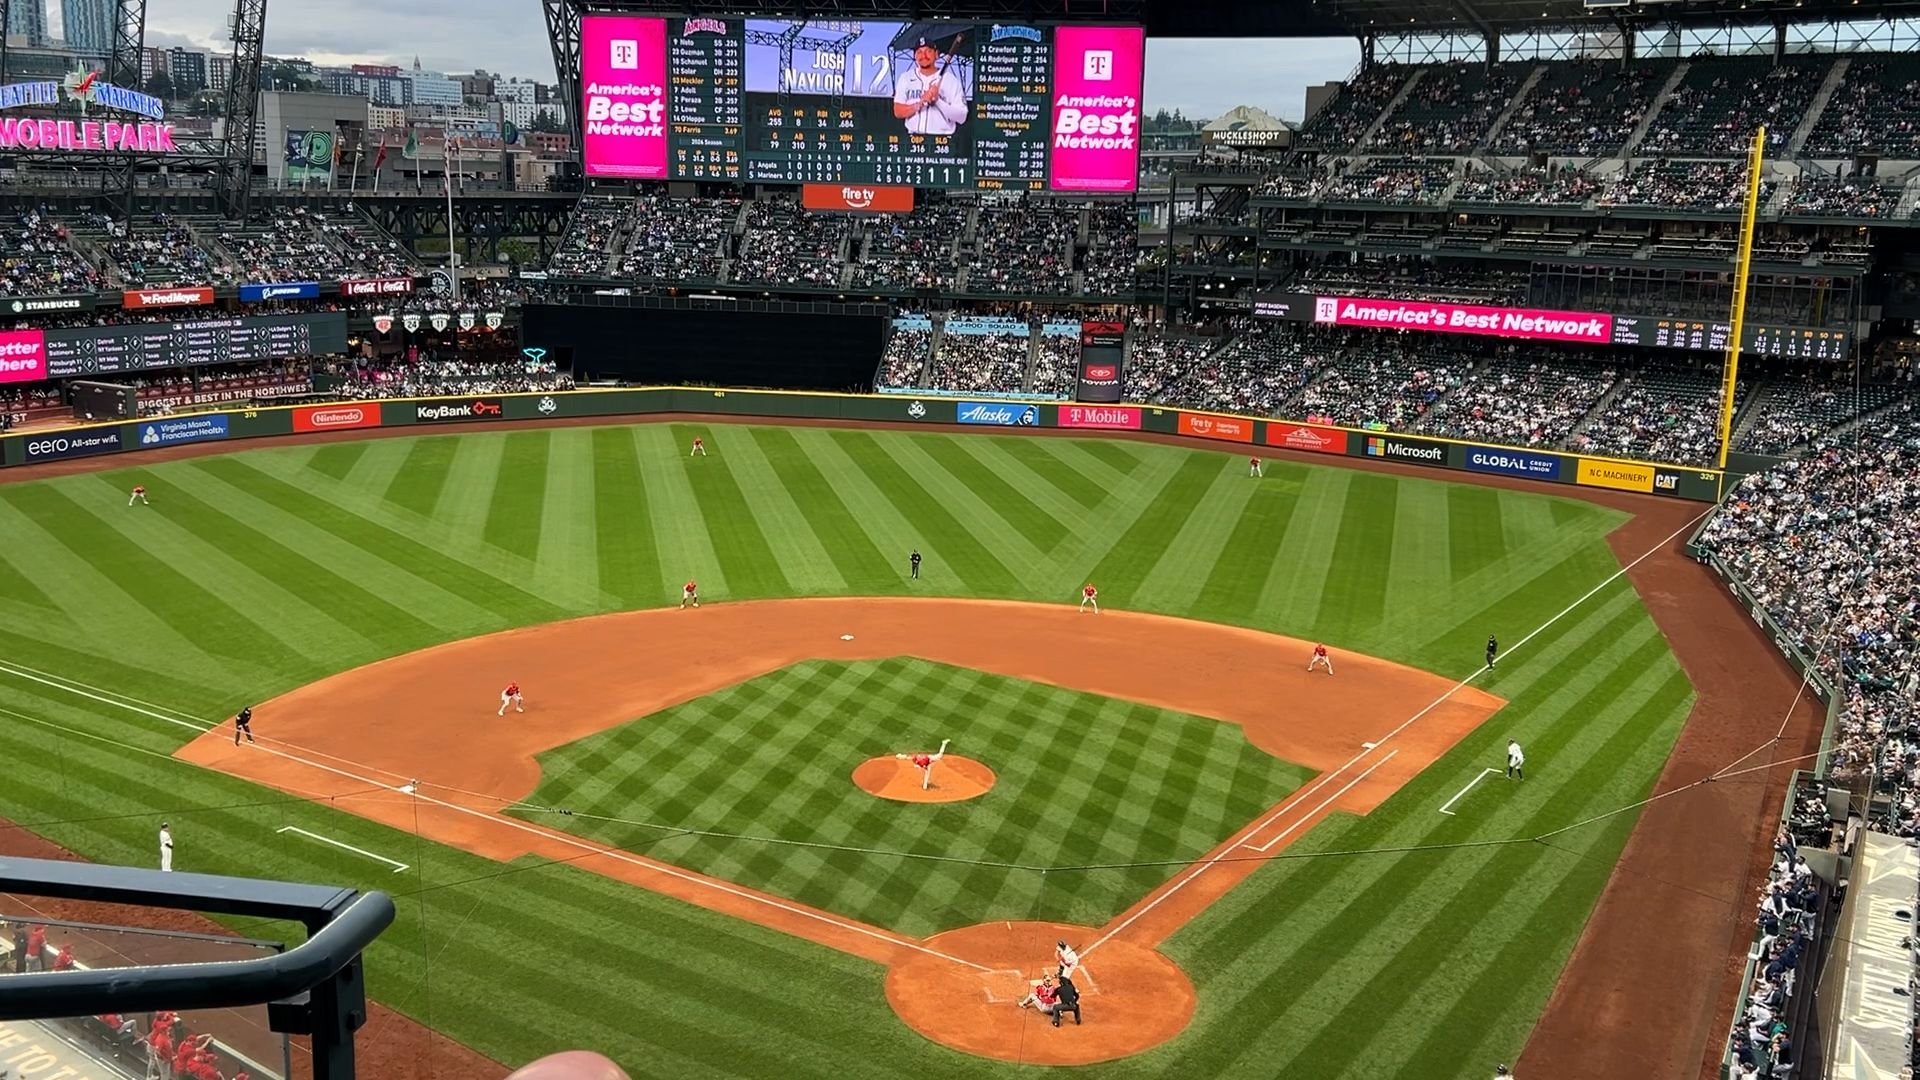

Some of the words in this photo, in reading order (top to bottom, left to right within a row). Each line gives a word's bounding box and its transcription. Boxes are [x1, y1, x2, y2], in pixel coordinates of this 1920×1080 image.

[683, 18, 726, 36] ANGELS
[813, 49, 844, 70] JOSH
[785, 68, 844, 92] NAYLOR
[851, 54, 890, 95] 12
[587, 82, 662, 96] America's
[96, 82, 164, 120] MARINERS
[1056, 94, 1135, 108] America's
[587, 97, 665, 122] Best
[1056, 108, 1136, 135] Best
[104, 122, 176, 152] PARK
[587, 122, 664, 137] Network
[1055, 135, 1134, 149] Network
[985, 150, 1004, 159] Young
[758, 161, 777, 169] Angels
[842, 188, 862, 200] fire
[862, 188, 874, 200] tv
[26, 300, 80, 310] STARBUCKS
[1341, 303, 1446, 326] America's
[1450, 310, 1500, 329] Best
[1502, 314, 1604, 337] Network
[194, 394, 219, 403] BEST
[221, 392, 232, 400] IN
[234, 390, 252, 399] THE
[255, 384, 312, 396] NORTHWES
[315, 412, 360, 423] Nintendo
[418, 404, 471, 420] KeyBank
[961, 405, 1011, 422] Alaska
[1084, 409, 1129, 424] Mobile
[161, 422, 186, 432] Virginia
[188, 420, 211, 428] Mason
[1191, 418, 1204, 427] fire
[1205, 419, 1212, 428] tv
[162, 430, 198, 440] Franciscan
[199, 427, 223, 436] Health
[28, 439, 69, 455] eero
[72, 436, 100, 448] All-star
[1386, 442, 1442, 460] Microsoft
[1473, 453, 1526, 470] GLOBAL
[1529, 465, 1550, 473] UNION
[1604, 470, 1647, 482] MACHINERY
[1656, 474, 1679, 489] CAT
